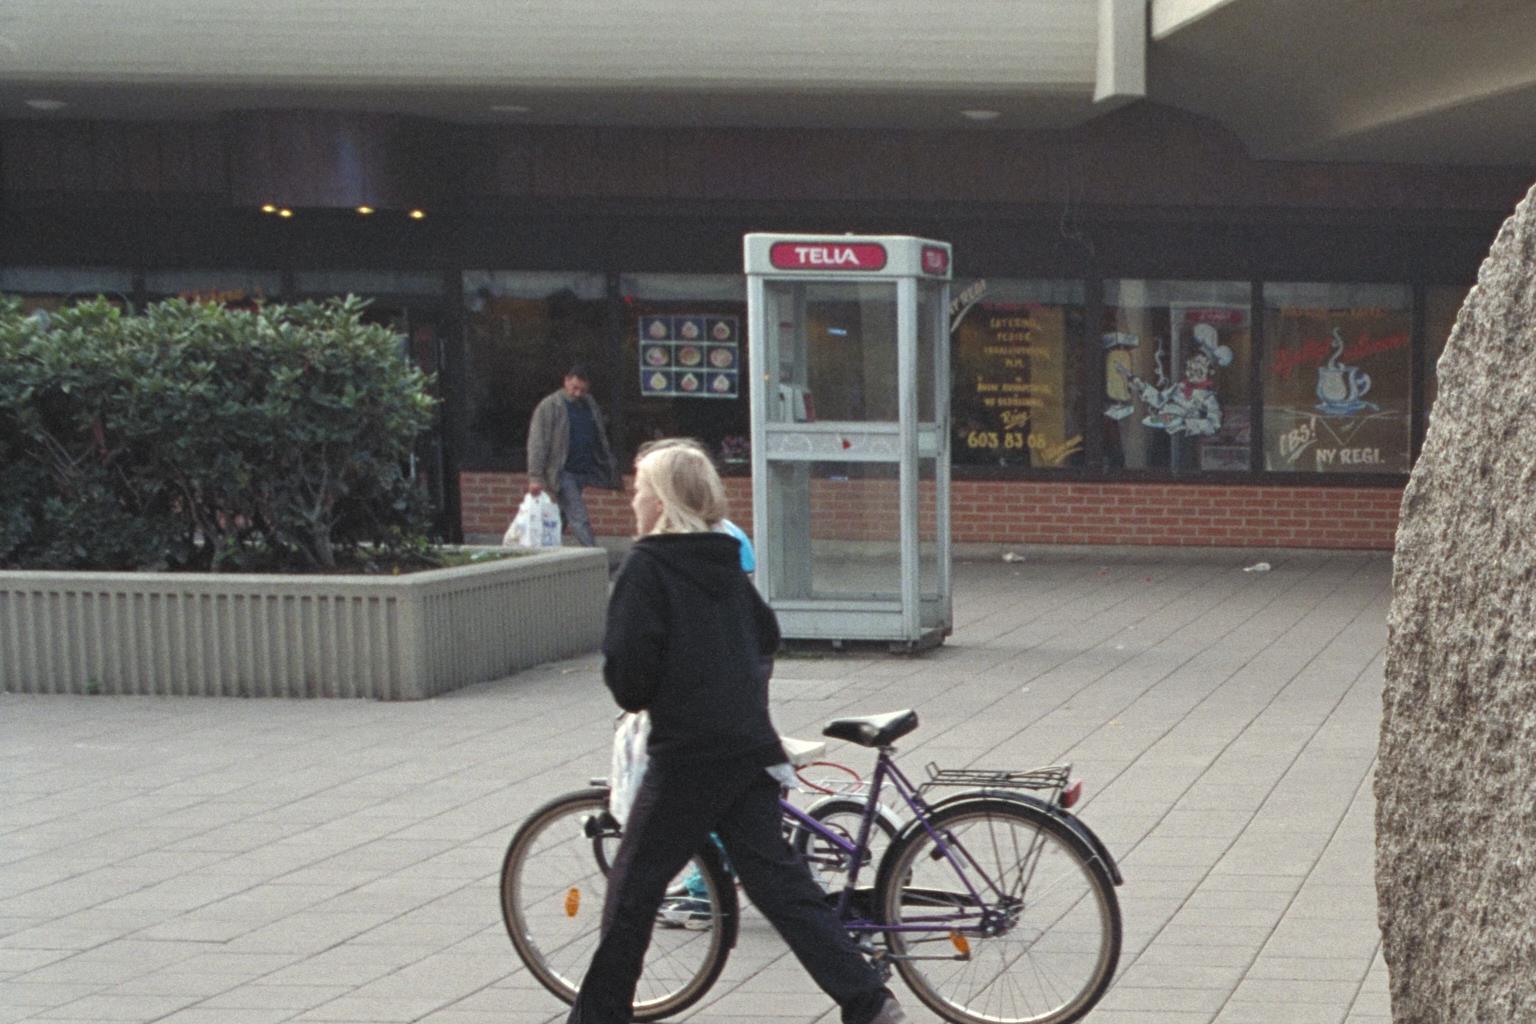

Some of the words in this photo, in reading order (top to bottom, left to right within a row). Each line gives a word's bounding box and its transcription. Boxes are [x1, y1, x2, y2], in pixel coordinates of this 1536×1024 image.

[795, 247, 860, 265] TELIA
[967, 431, 999, 448] 603
[1004, 431, 1023, 448] 83
